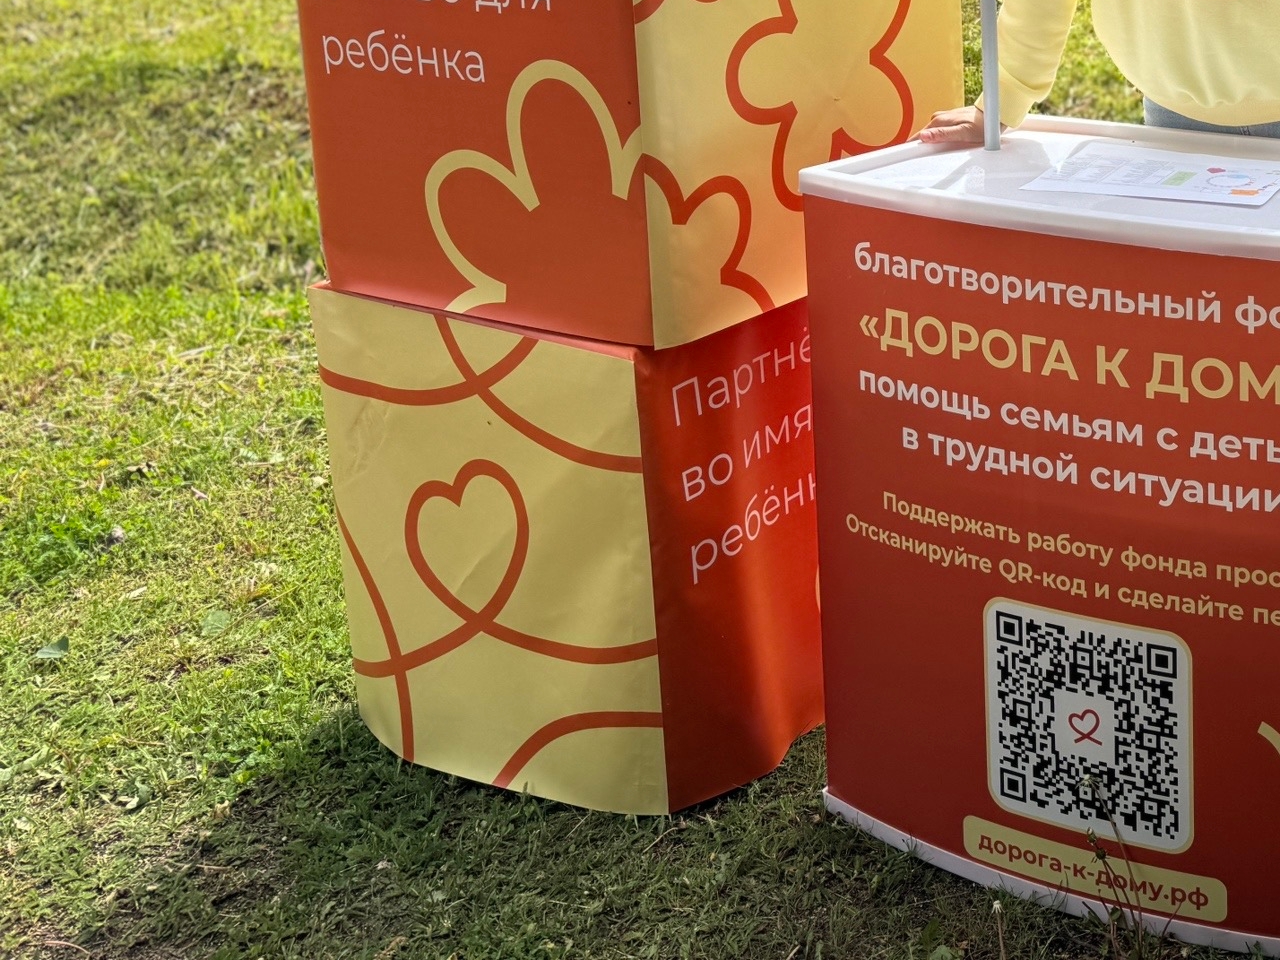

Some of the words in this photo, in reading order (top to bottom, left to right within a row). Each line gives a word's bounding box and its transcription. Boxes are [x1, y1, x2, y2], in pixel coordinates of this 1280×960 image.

[322, 29, 485, 83] ребёнка
[854, 242, 1222, 324] благотворительный
[859, 307, 1079, 381] «ДОРОГА
[1096, 345, 1130, 388] К
[859, 368, 991, 419] помощь
[1000, 399, 1143, 446] семьям
[1156, 427, 1179, 450] с
[681, 453, 733, 502] во
[743, 404, 812, 469] имя
[902, 427, 919, 450] в
[928, 430, 1078, 485] трудной
[845, 514, 993, 574] Отсканируйте
[999, 559, 1087, 598] QR-код
[1094, 581, 1109, 600] и
[1117, 584, 1244, 623] сделайте
[882, 491, 1021, 544] Поддержать
[1027, 531, 1113, 567] работу
[1120, 545, 1207, 579] фонда
[978, 834, 1209, 910] дорога-к-дому.рф
